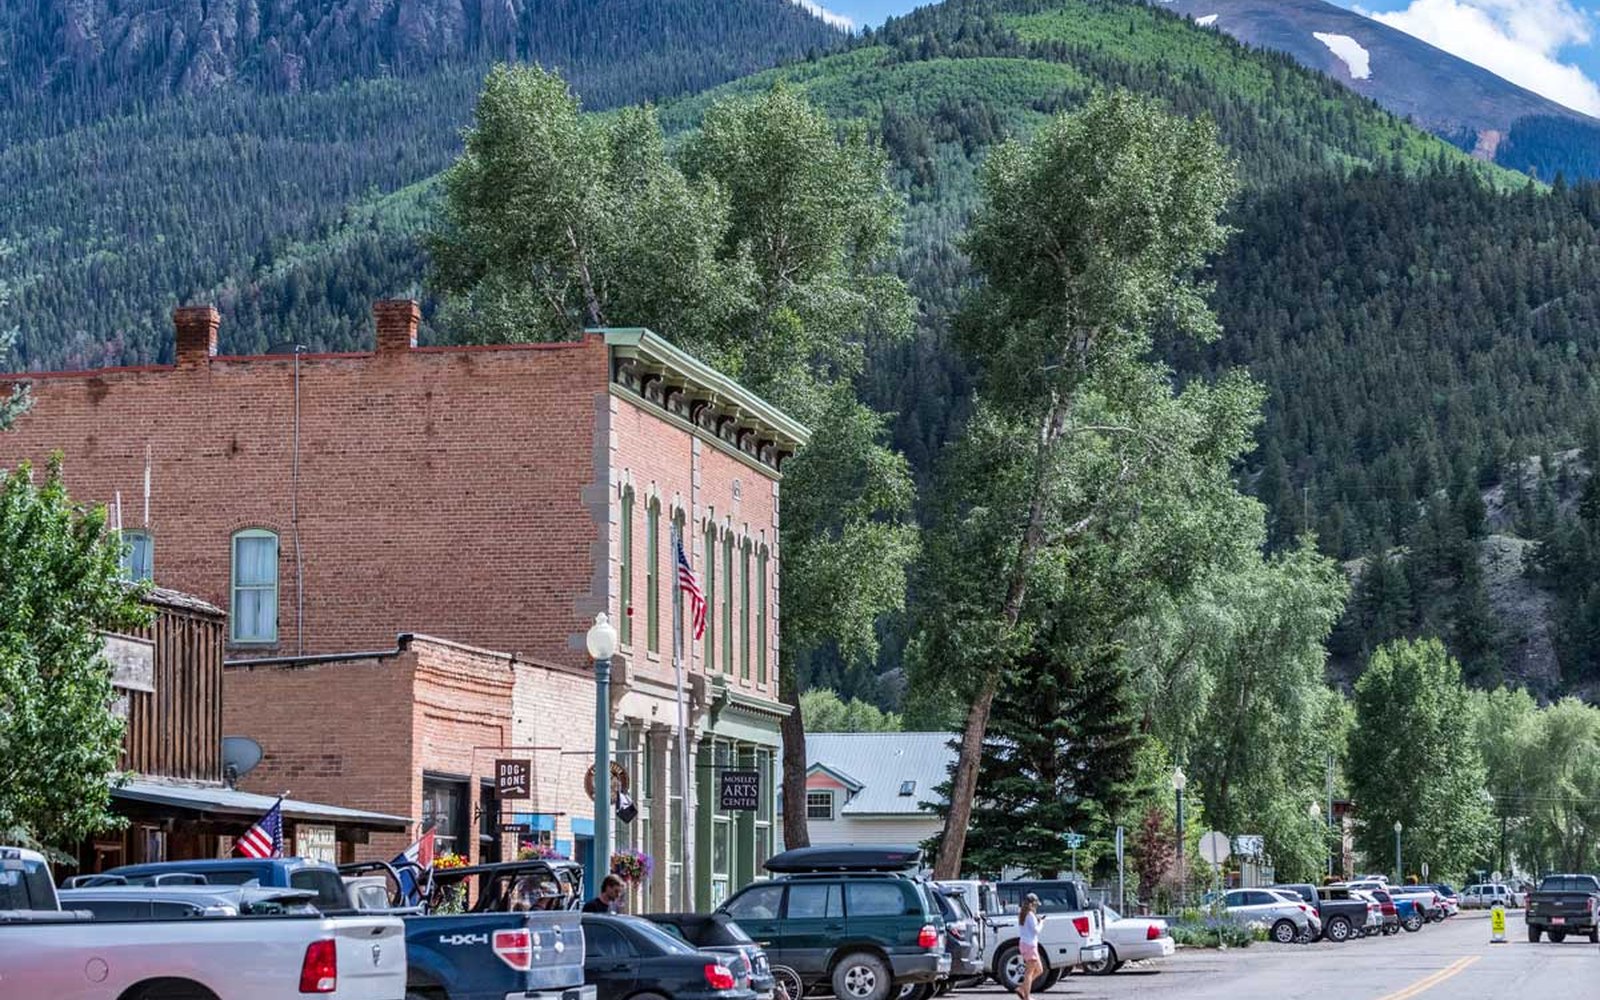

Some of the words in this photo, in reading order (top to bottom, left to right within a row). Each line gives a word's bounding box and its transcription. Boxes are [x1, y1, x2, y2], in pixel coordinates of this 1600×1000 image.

[501, 775, 525, 787] BONE
[724, 785, 757, 797] ARTS
[723, 798, 756, 806] CENTER
